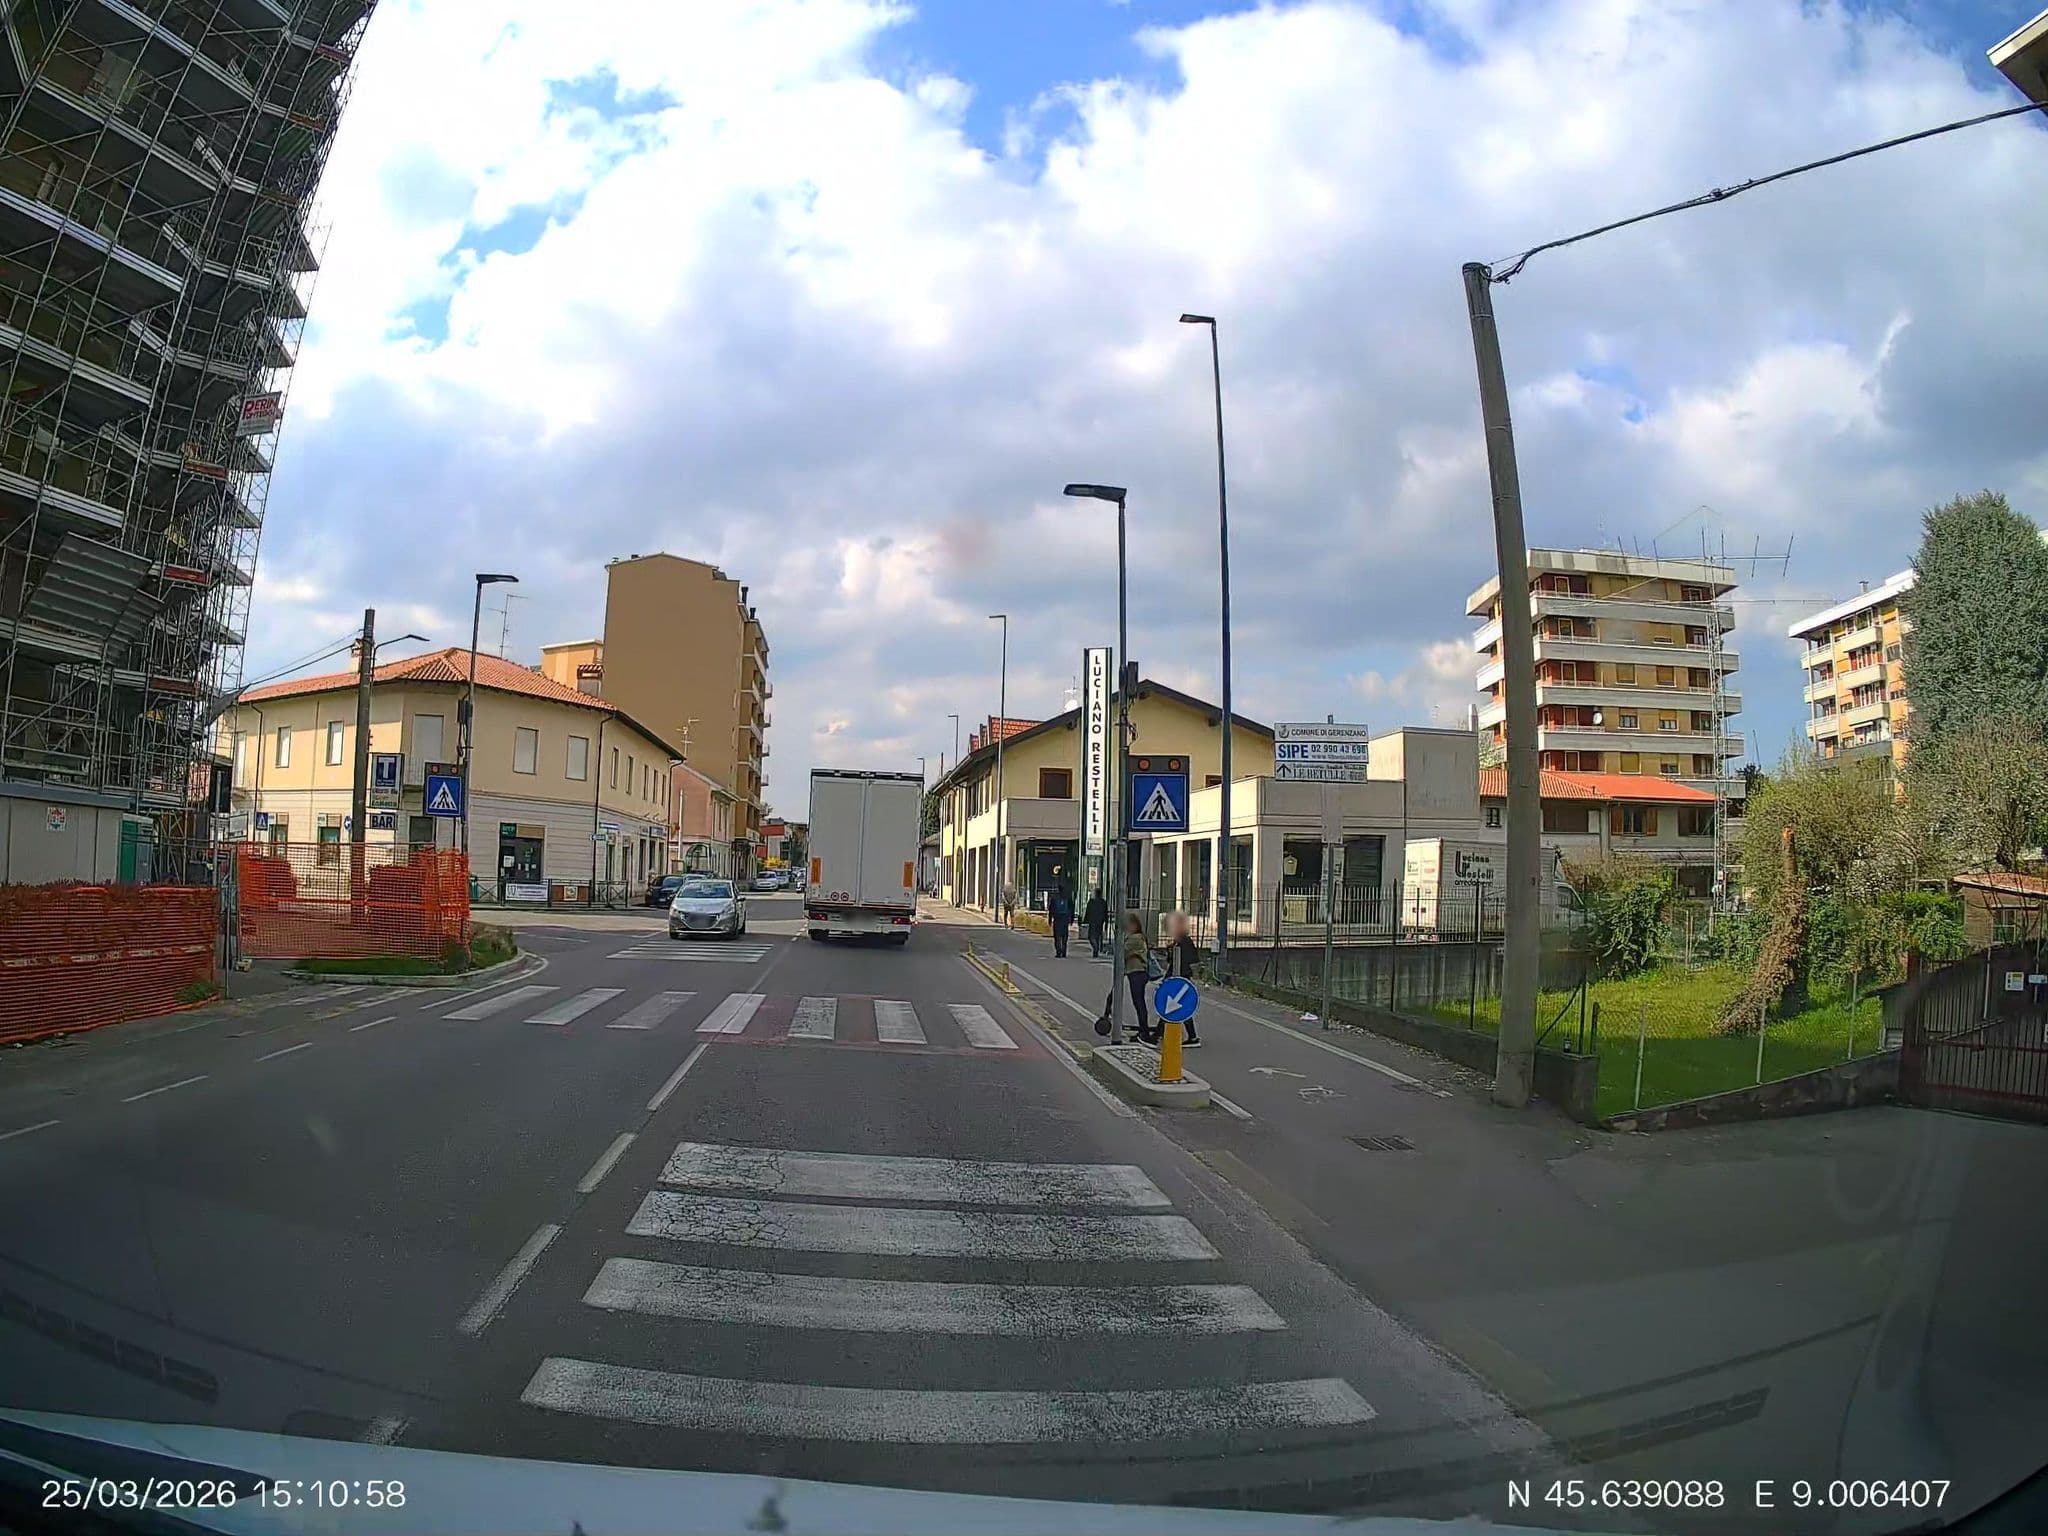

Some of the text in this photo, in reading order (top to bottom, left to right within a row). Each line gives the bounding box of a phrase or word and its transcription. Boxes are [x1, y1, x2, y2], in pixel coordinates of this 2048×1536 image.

[1091, 655, 1101, 734] LUCIANO
[1327, 729, 1366, 737] GERENZANO
[1278, 744, 1309, 758] SIPE
[1311, 744, 1321, 753] 02
[1323, 745, 1338, 753] 990
[1091, 742, 1100, 834] RESTELLI
[372, 815, 393, 828] BAR
